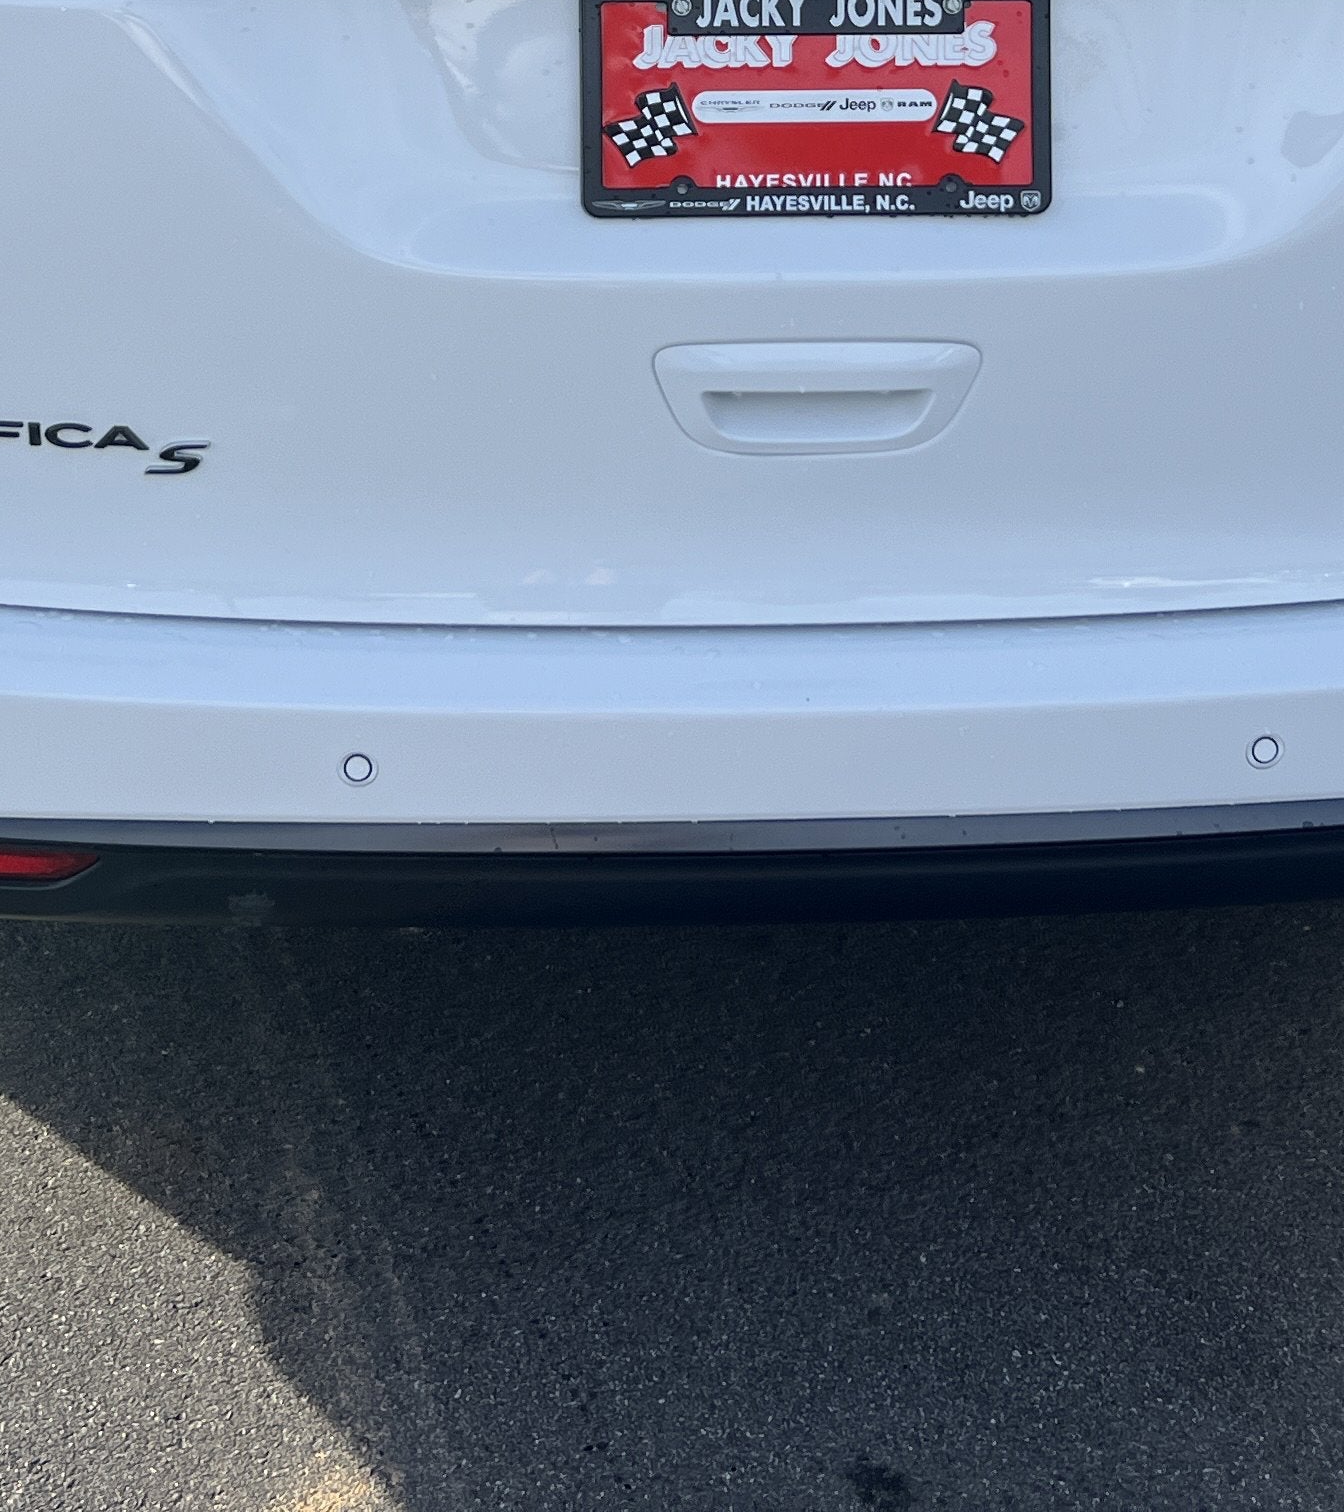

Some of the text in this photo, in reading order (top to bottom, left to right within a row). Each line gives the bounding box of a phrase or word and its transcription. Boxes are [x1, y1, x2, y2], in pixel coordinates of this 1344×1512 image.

[632, 20, 998, 70] JACKY JONES
[839, 97, 877, 112] Jeep
[897, 100, 933, 108] RAM
[669, 190, 1015, 213] DODGE HAYESVILLE, N.C. Jeep
[144, 439, 212, 475] S
